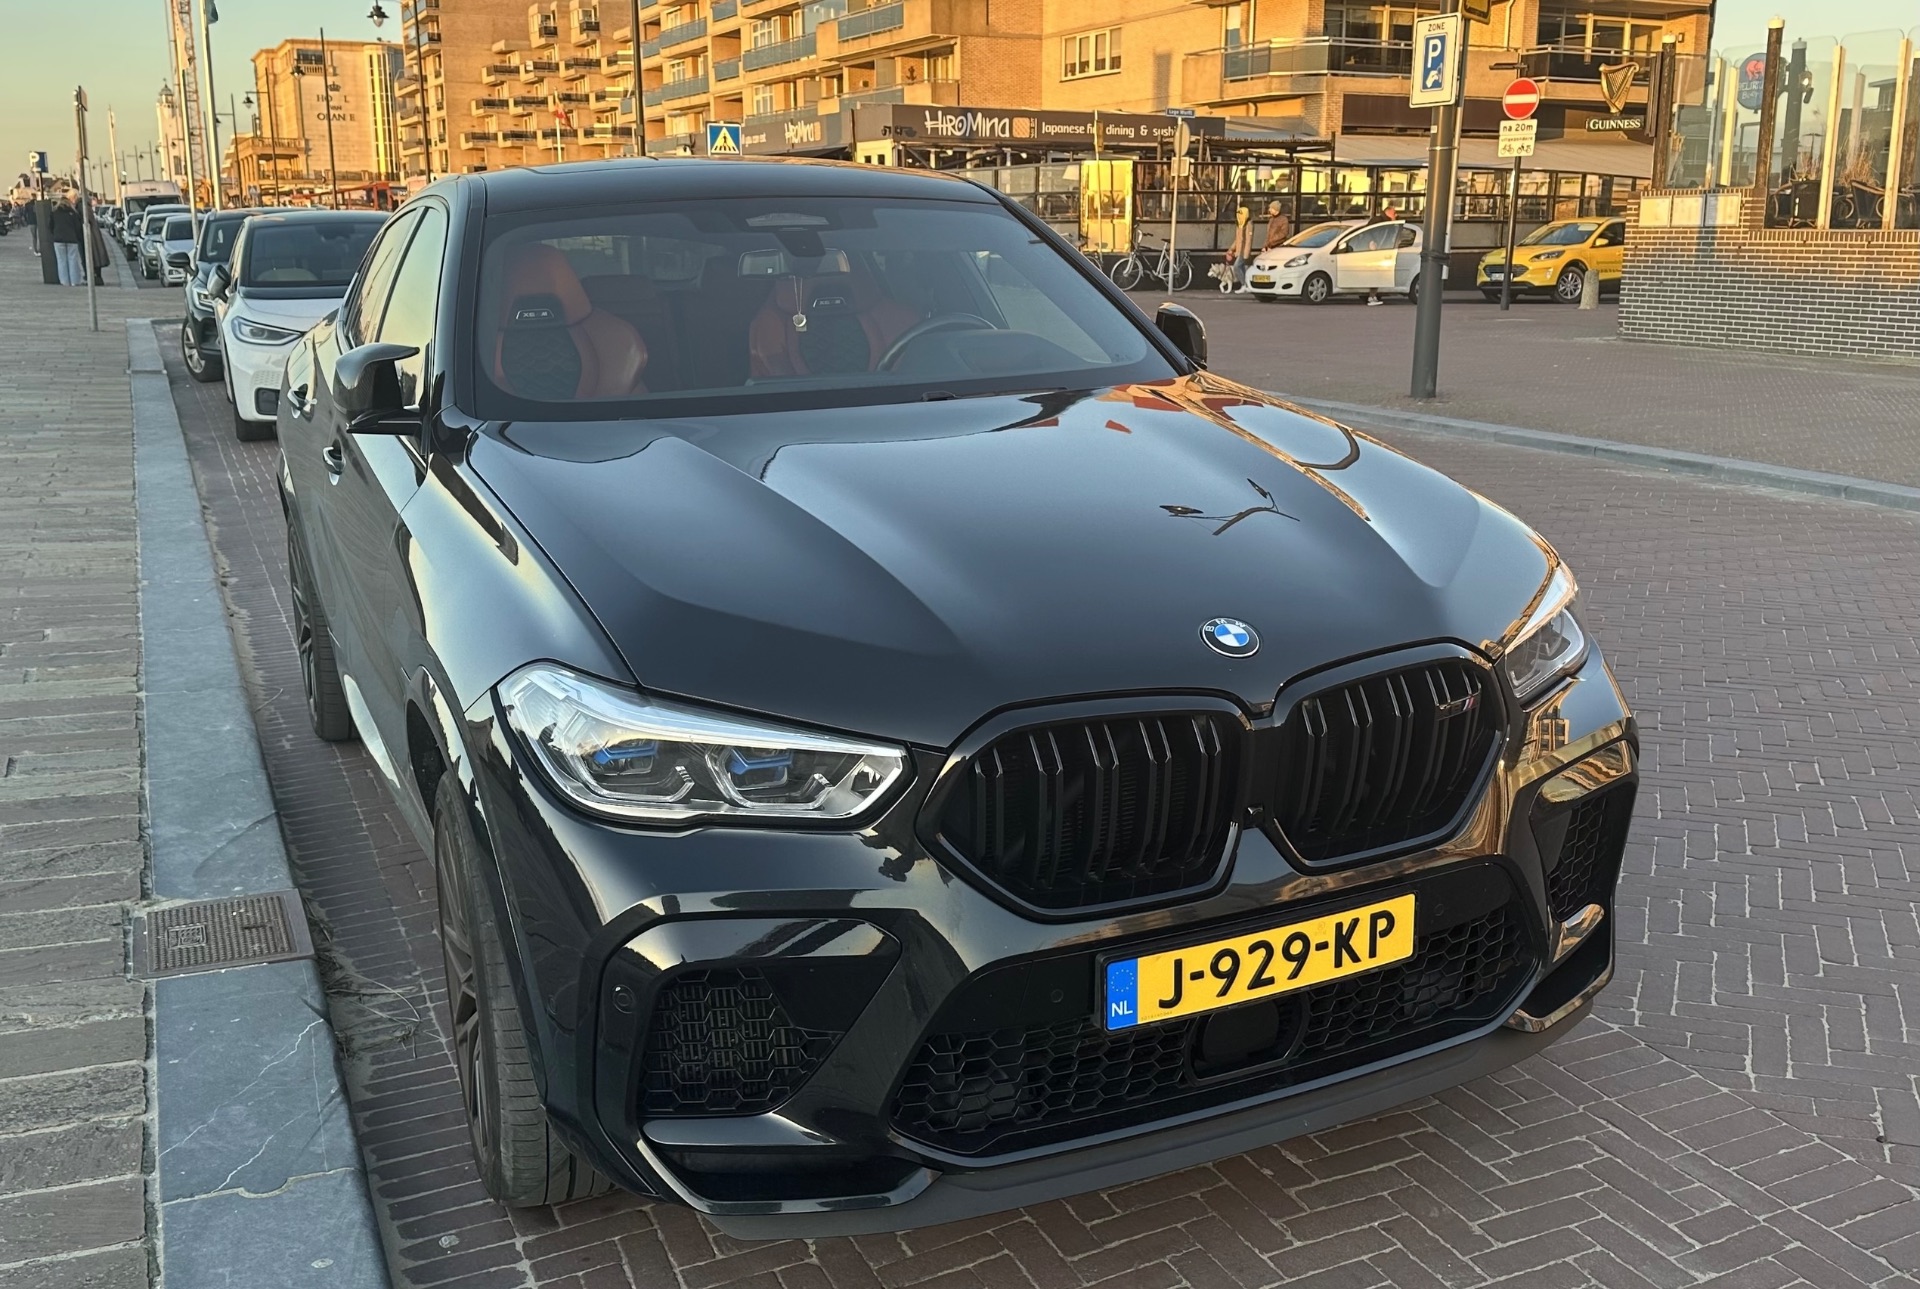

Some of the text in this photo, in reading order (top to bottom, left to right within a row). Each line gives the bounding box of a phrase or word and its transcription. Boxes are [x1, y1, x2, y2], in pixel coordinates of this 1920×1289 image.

[1428, 22, 1445, 32] ZONE
[1427, 38, 1442, 68] P
[1042, 121, 1085, 135] Japanese
[1105, 123, 1135, 138] dining
[1140, 125, 1148, 136] &
[1515, 123, 1534, 132] 20m
[1589, 119, 1641, 130] GUINNESS
[1158, 909, 1396, 1009] J-929-KP
[1111, 1000, 1134, 1018] NL
